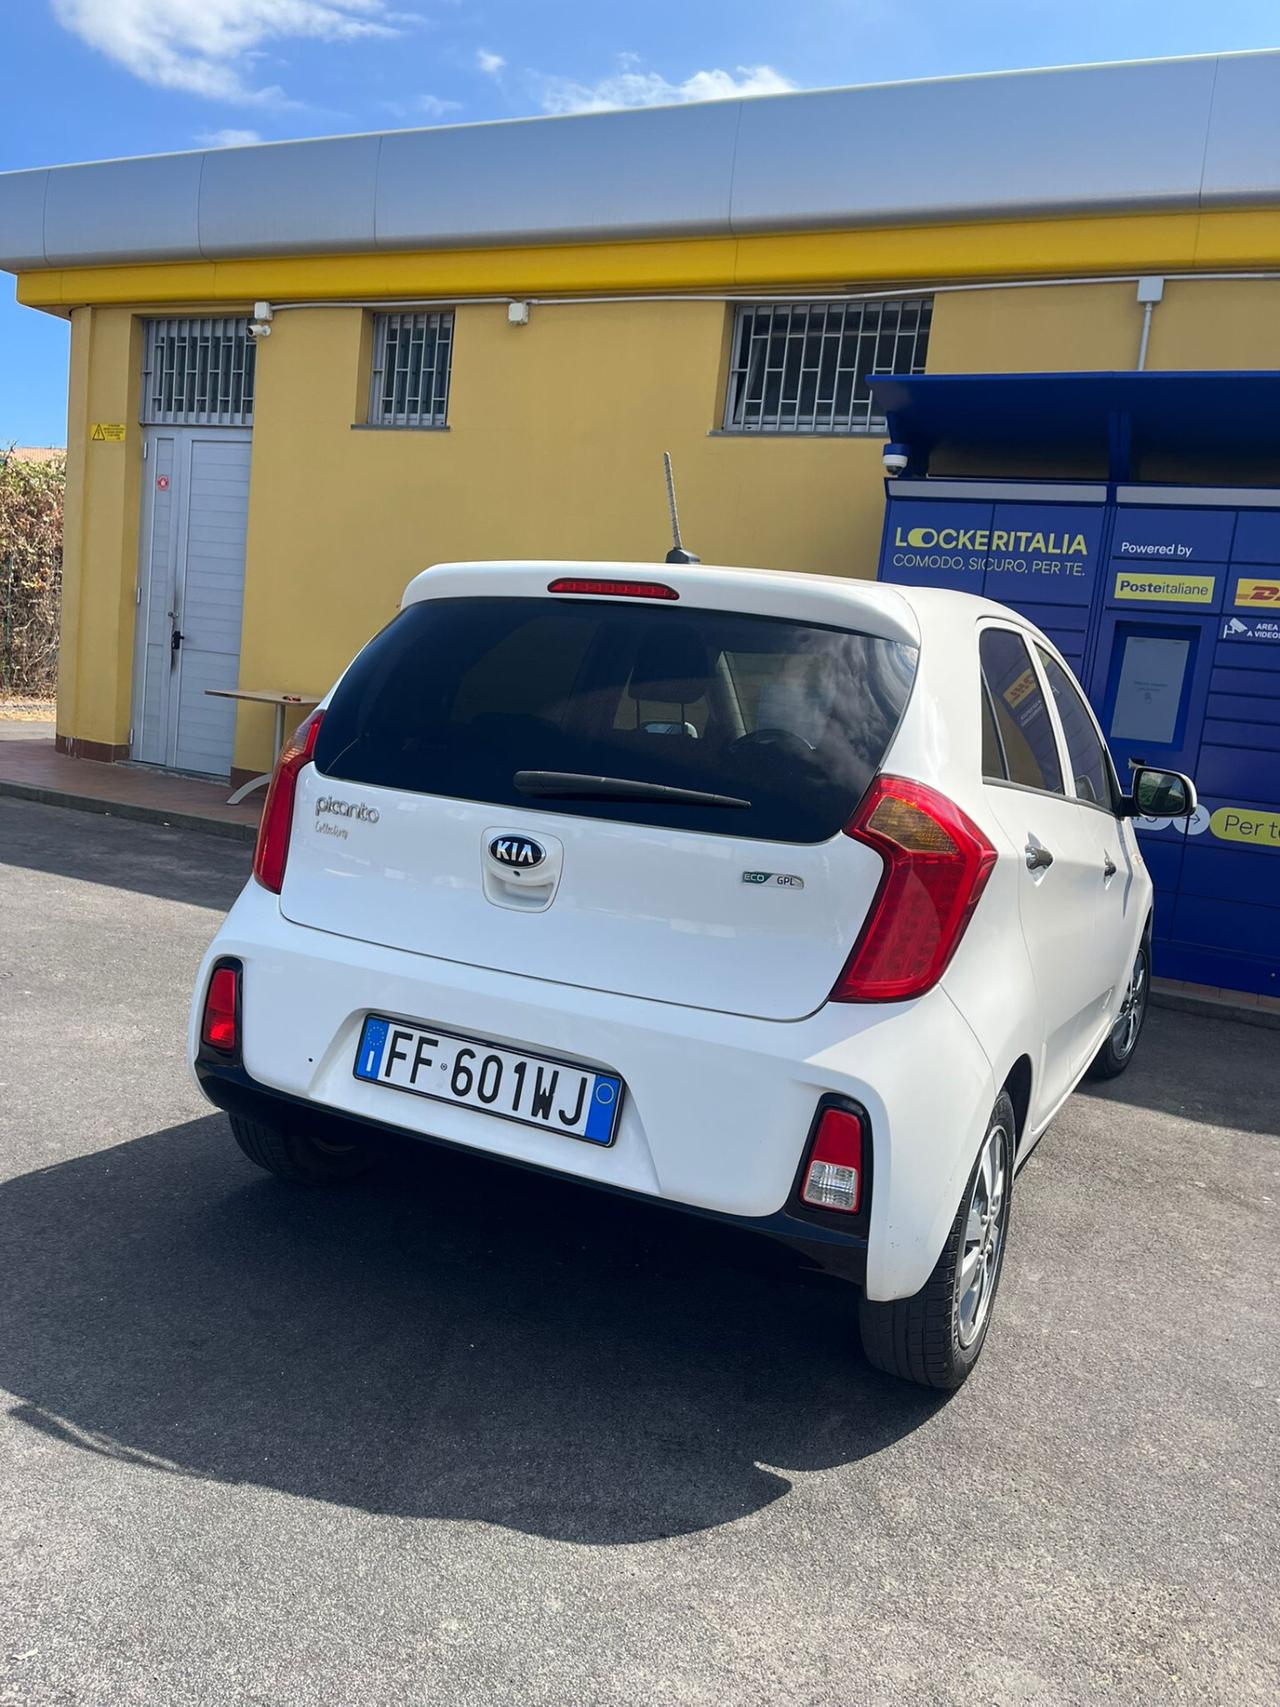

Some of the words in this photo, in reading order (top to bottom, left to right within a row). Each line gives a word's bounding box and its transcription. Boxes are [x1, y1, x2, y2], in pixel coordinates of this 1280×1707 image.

[1121, 542, 1175, 555] Powered
[1177, 544, 1193, 558] by
[893, 553, 966, 571] COMODO,
[968, 557, 1028, 574] SICURO,
[1032, 560, 1061, 575] PER
[1064, 562, 1086, 576] TE.
[1119, 580, 1209, 596] Posteitaliane
[1254, 631, 1280, 639] VIDEO
[1255, 623, 1279, 631] AREA
[315, 794, 380, 823] picanto
[1224, 815, 1264, 837] Per
[496, 840, 534, 863] KIA
[744, 873, 766, 882] ECO
[776, 876, 795, 886] GPL
